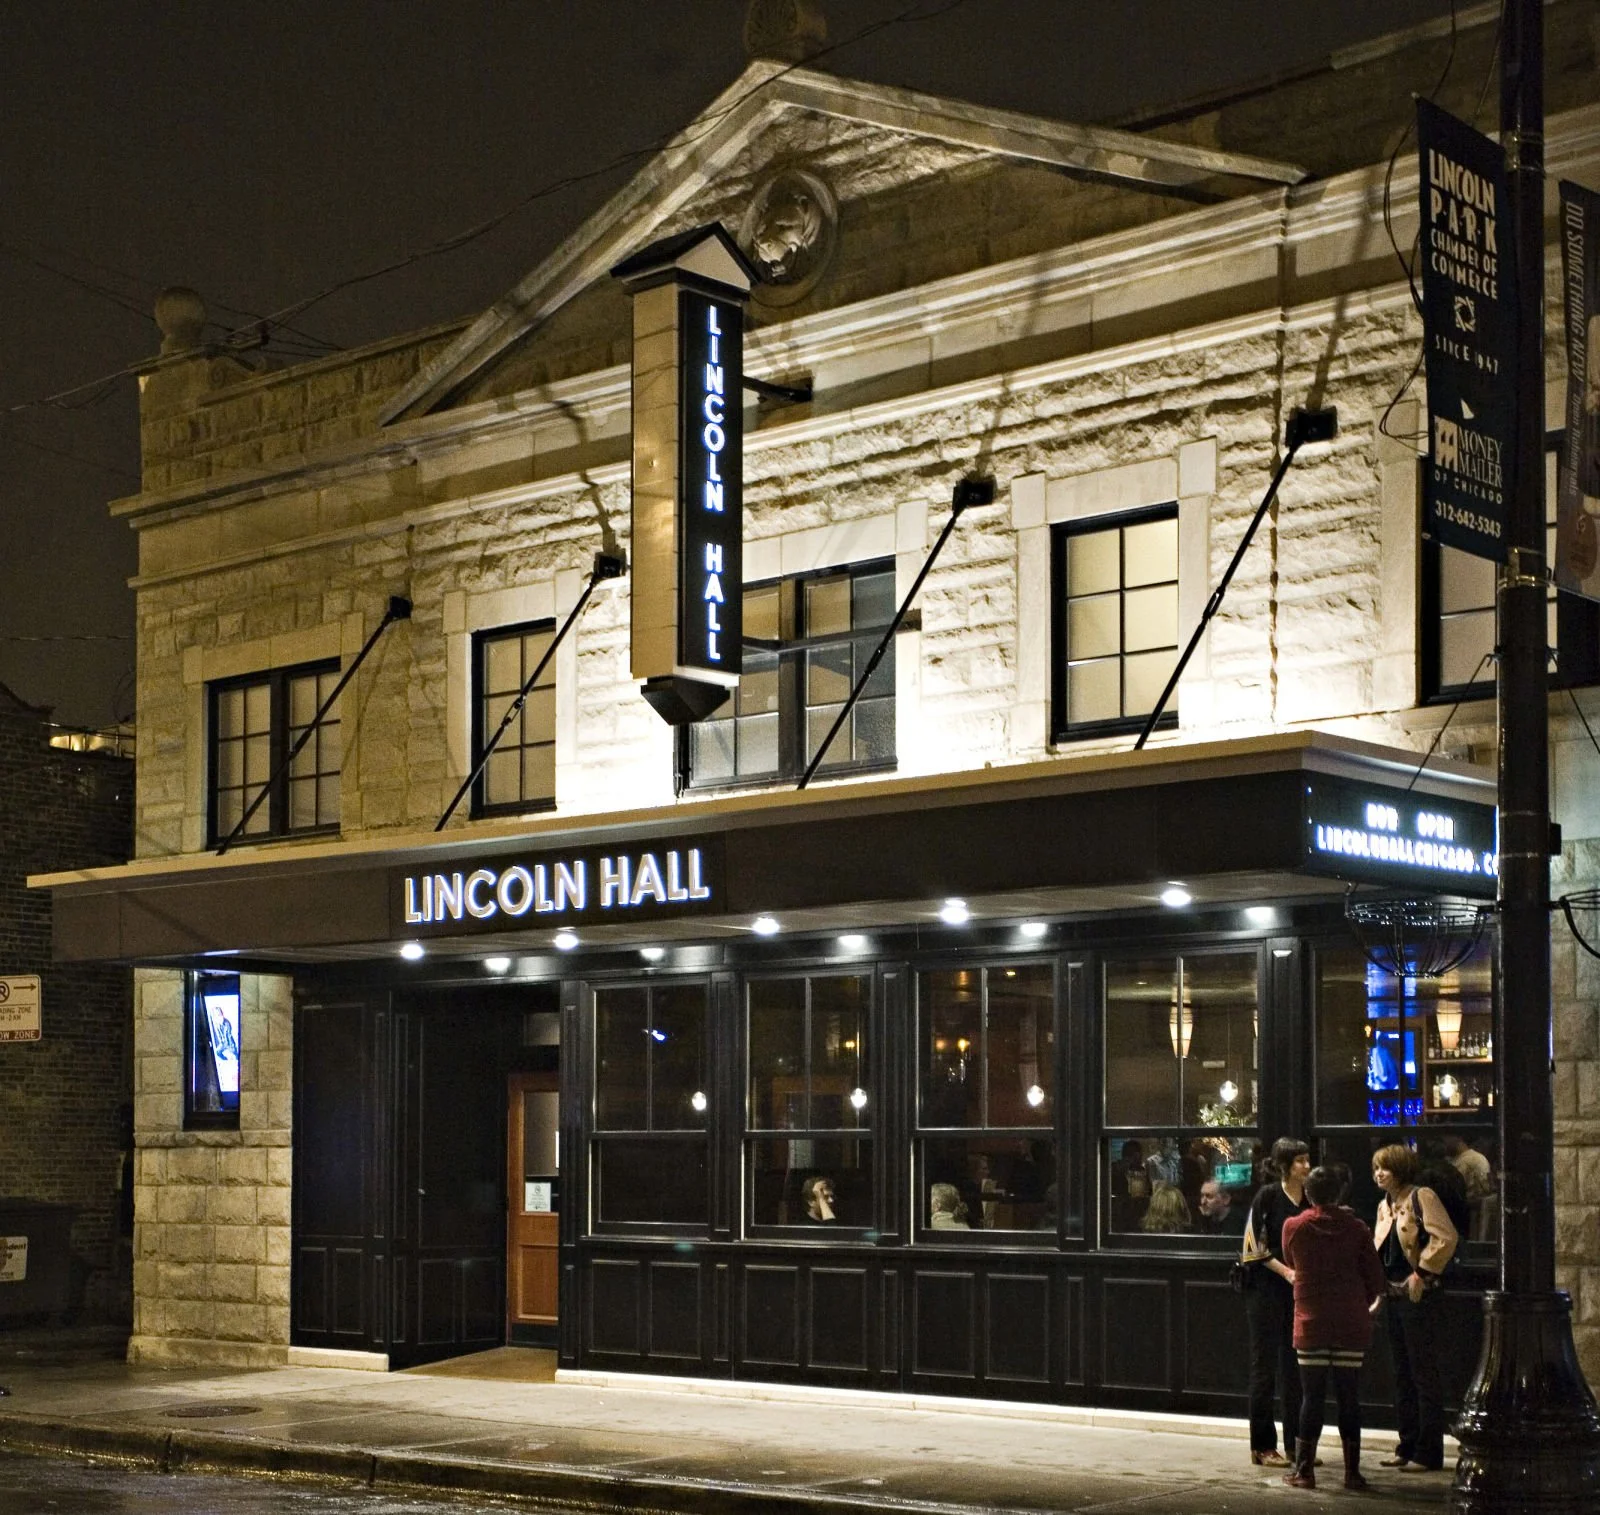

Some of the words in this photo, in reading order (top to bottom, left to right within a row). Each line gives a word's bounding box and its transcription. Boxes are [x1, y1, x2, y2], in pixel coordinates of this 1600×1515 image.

[1429, 148, 1495, 217] LINCOLN
[1566, 201, 1584, 230] DO
[1431, 228, 1479, 268] CHAMBER
[1483, 254, 1498, 277] OF
[1431, 251, 1498, 300] COMMERCE
[1567, 230, 1585, 337] SOMETHING
[1434, 333, 1470, 362] SINCE
[1571, 337, 1585, 382] NEW
[703, 304, 725, 512] LINCOLN
[1458, 425, 1502, 464] MONEY
[1434, 469, 1448, 485] OF
[1454, 478, 1503, 505] CHICAGO
[1458, 451, 1502, 488] MAILER
[703, 542, 725, 661] HALL
[1417, 812, 1454, 840] OPEN
[404, 859, 585, 923] LINCOLN
[599, 848, 710, 907] HALL
[14, 1031, 36, 1040] ZONE
